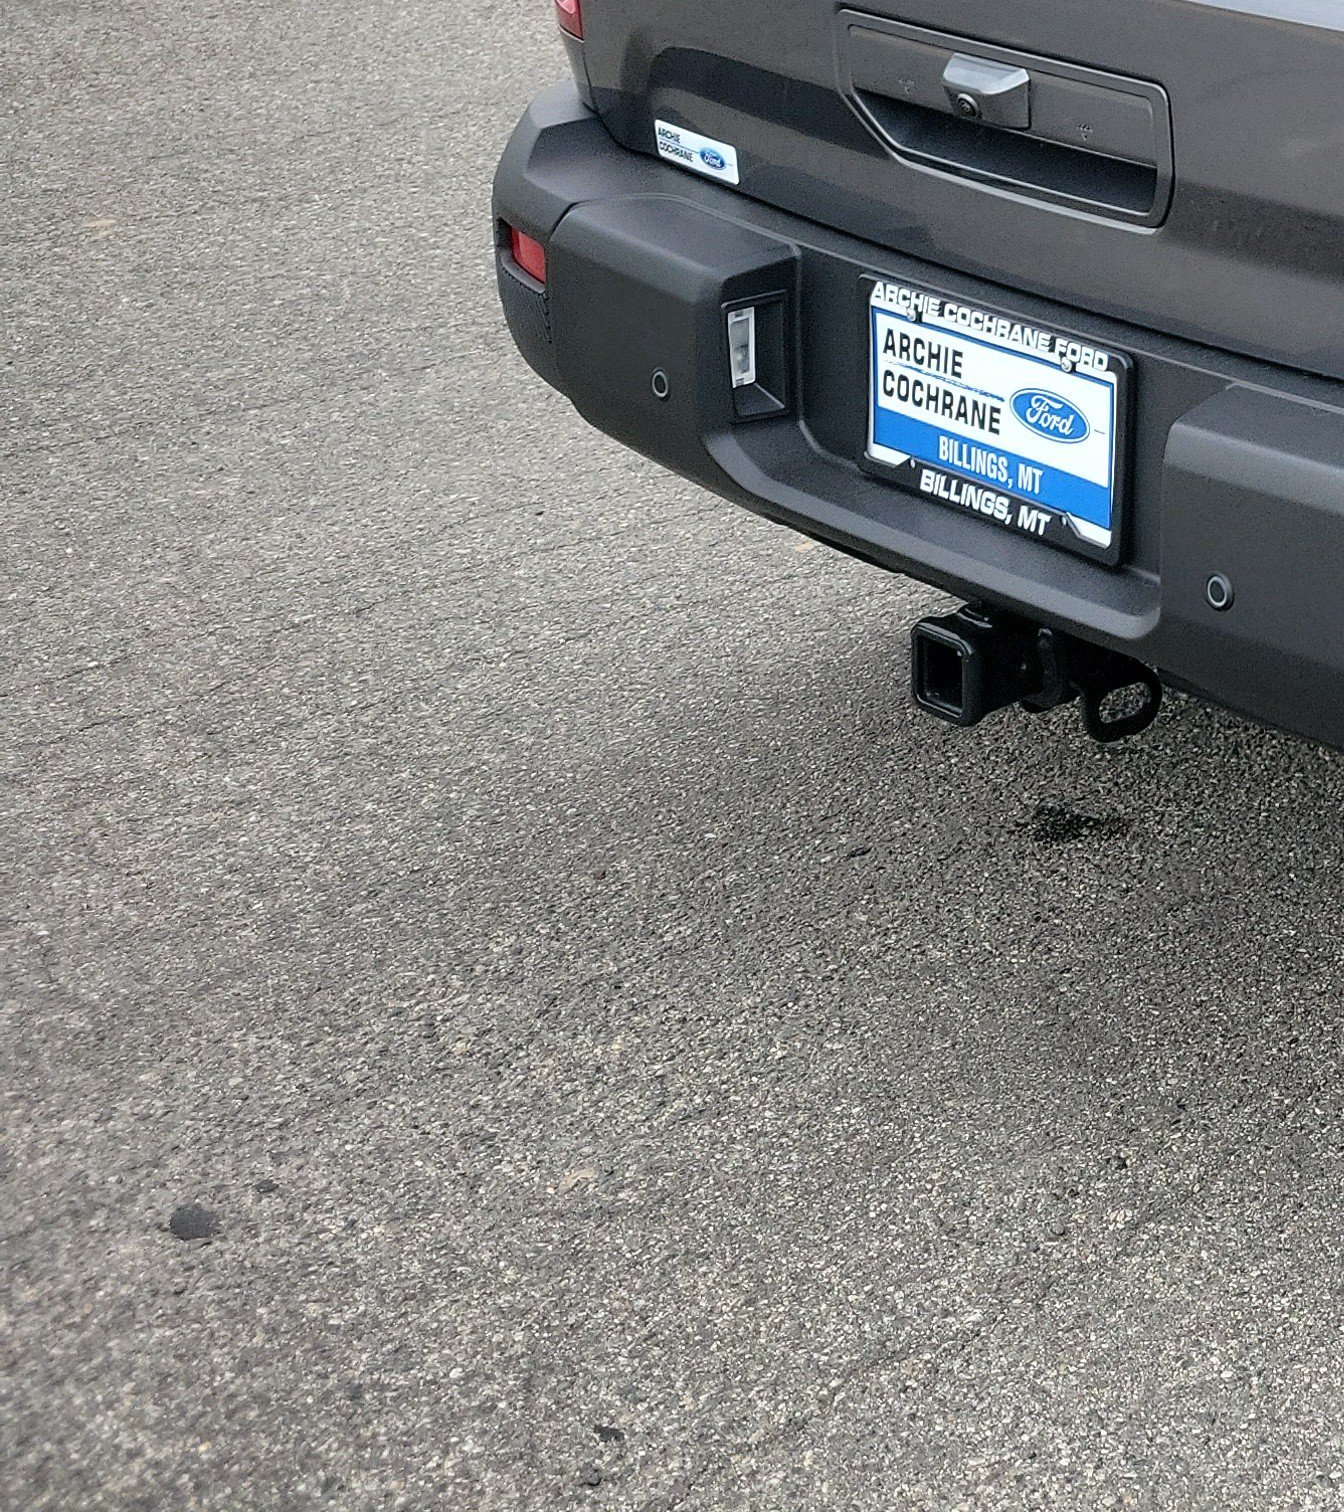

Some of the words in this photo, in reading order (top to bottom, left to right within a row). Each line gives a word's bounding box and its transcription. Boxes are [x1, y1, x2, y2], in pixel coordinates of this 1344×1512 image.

[871, 281, 941, 319] ARCHIE
[943, 303, 1051, 352] COCHRANE
[1054, 338, 1109, 372] FORD
[882, 328, 964, 380] ARCHIE
[882, 369, 1002, 436] COCHRANE
[1025, 395, 1075, 436] Ford
[938, 435, 1013, 489] BILLINGS,
[1017, 464, 1044, 495] MT
[919, 469, 1012, 526] BILLINGS,
[1017, 505, 1052, 536] MT
